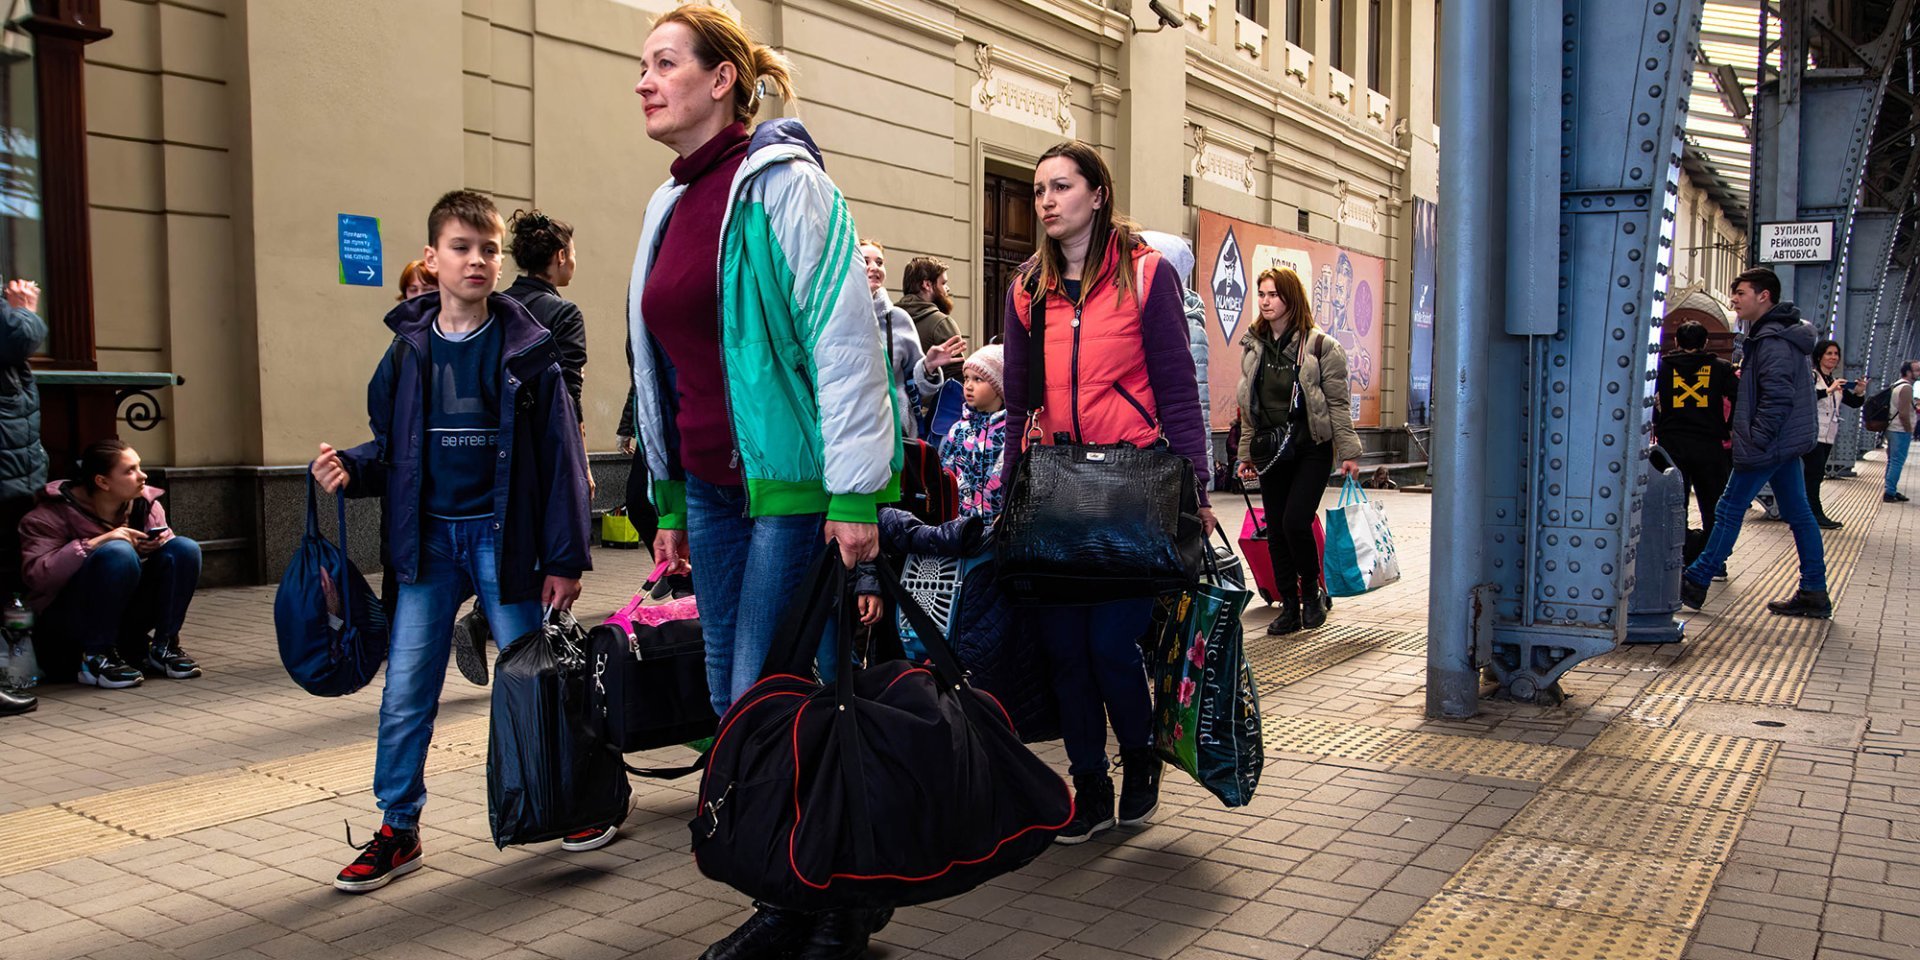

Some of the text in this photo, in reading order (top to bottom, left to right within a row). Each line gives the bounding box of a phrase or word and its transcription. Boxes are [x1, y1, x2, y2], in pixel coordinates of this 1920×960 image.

[1774, 225, 1819, 236] ЗУПИНКА
[1770, 236, 1822, 248] РЕЙКОВОГО
[1772, 249, 1818, 259] АВТОБУСА
[1223, 313, 1235, 322] 2008
[1200, 600, 1232, 745] music of wind
